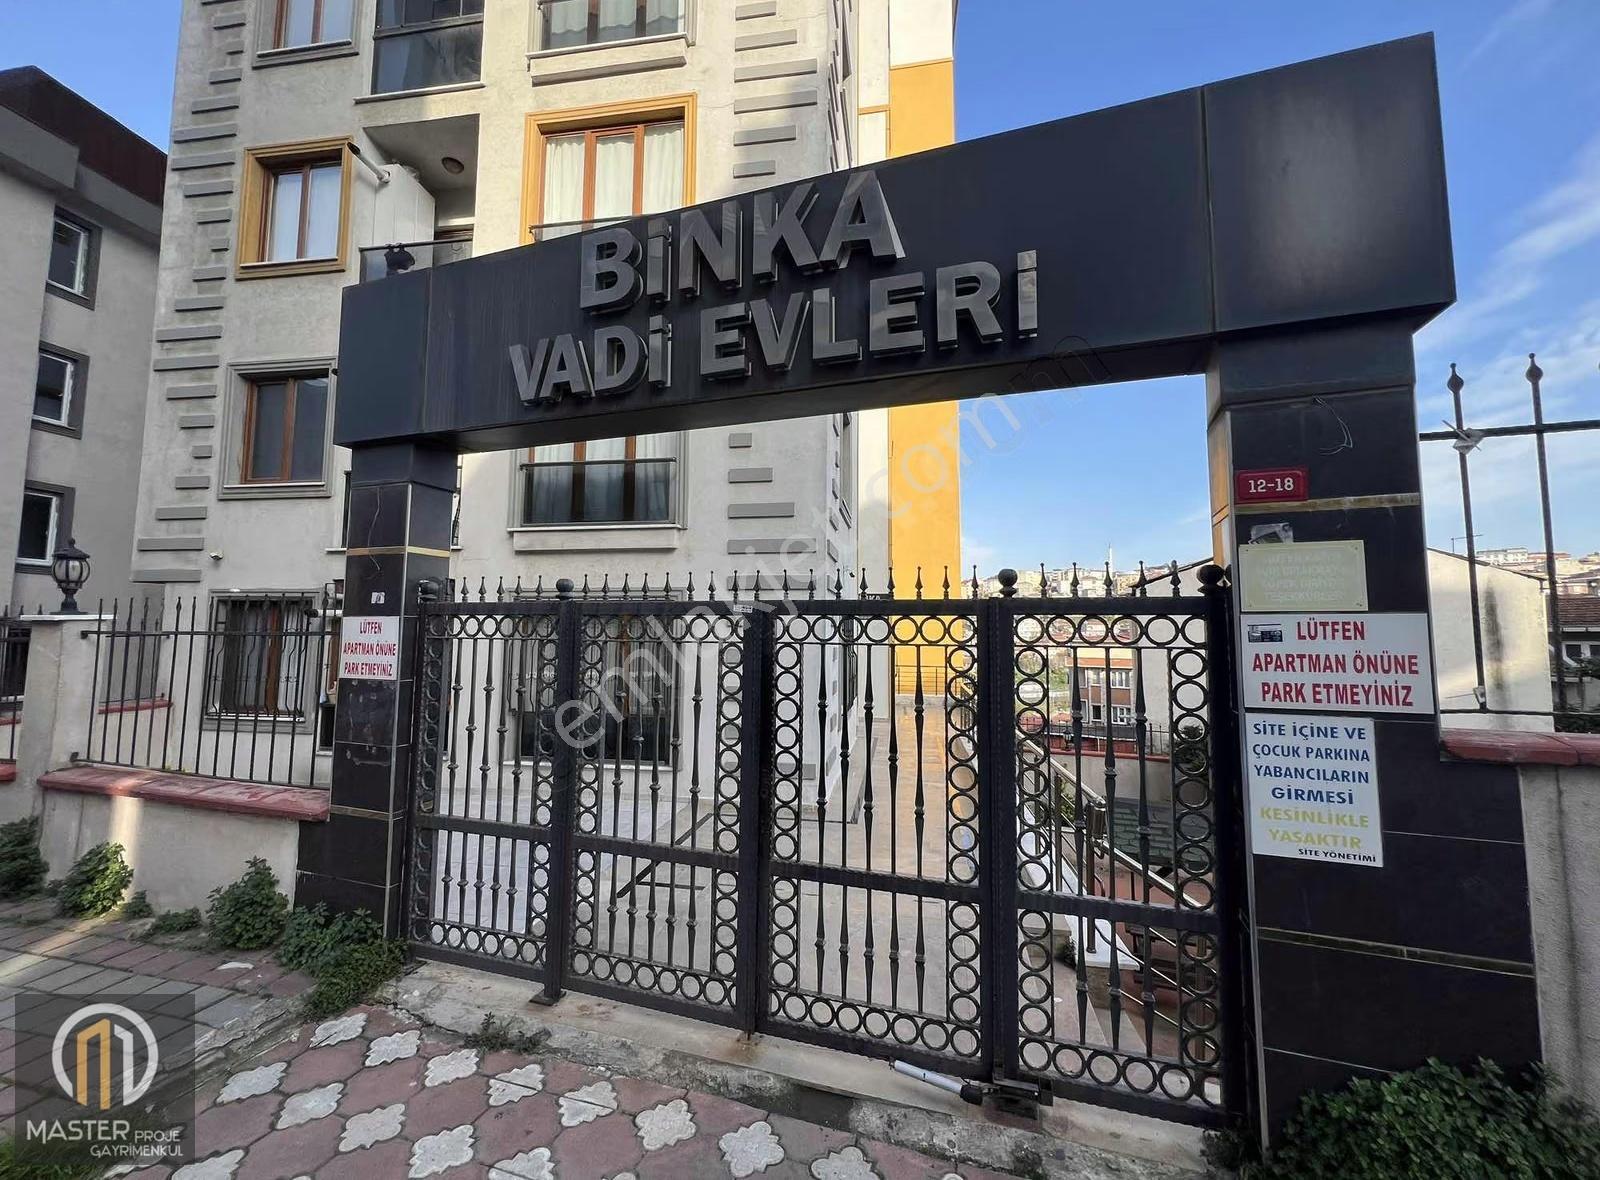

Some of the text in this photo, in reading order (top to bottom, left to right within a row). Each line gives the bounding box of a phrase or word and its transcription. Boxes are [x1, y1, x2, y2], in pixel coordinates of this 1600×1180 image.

[579, 169, 905, 312] BİNKA
[509, 315, 672, 405] VADİ
[700, 249, 1038, 380] EVLERİ
[1248, 477, 1294, 493] 12-18
[360, 619, 382, 634] LÜTFEN
[1297, 617, 1365, 640] LÜTFEN
[343, 640, 396, 656] APARTMAN ÖNÜNE
[344, 662, 359, 676] PARK
[1252, 651, 1419, 675] APARTMAN ÖNÜNE
[1261, 679, 1413, 707] PARK ETMEYİNİZ
[1253, 720, 1366, 740] SİTE İÇİNE VE
[1252, 744, 1370, 762] ÇOCUK PARKINA
[1254, 764, 1369, 783] YABANCILARIN
[1271, 784, 1354, 804] GİRMESİ
[1260, 807, 1369, 828] KESİNLİKLE
[1268, 829, 1361, 849] YASAKTIR
[1298, 848, 1320, 857] SİTE
